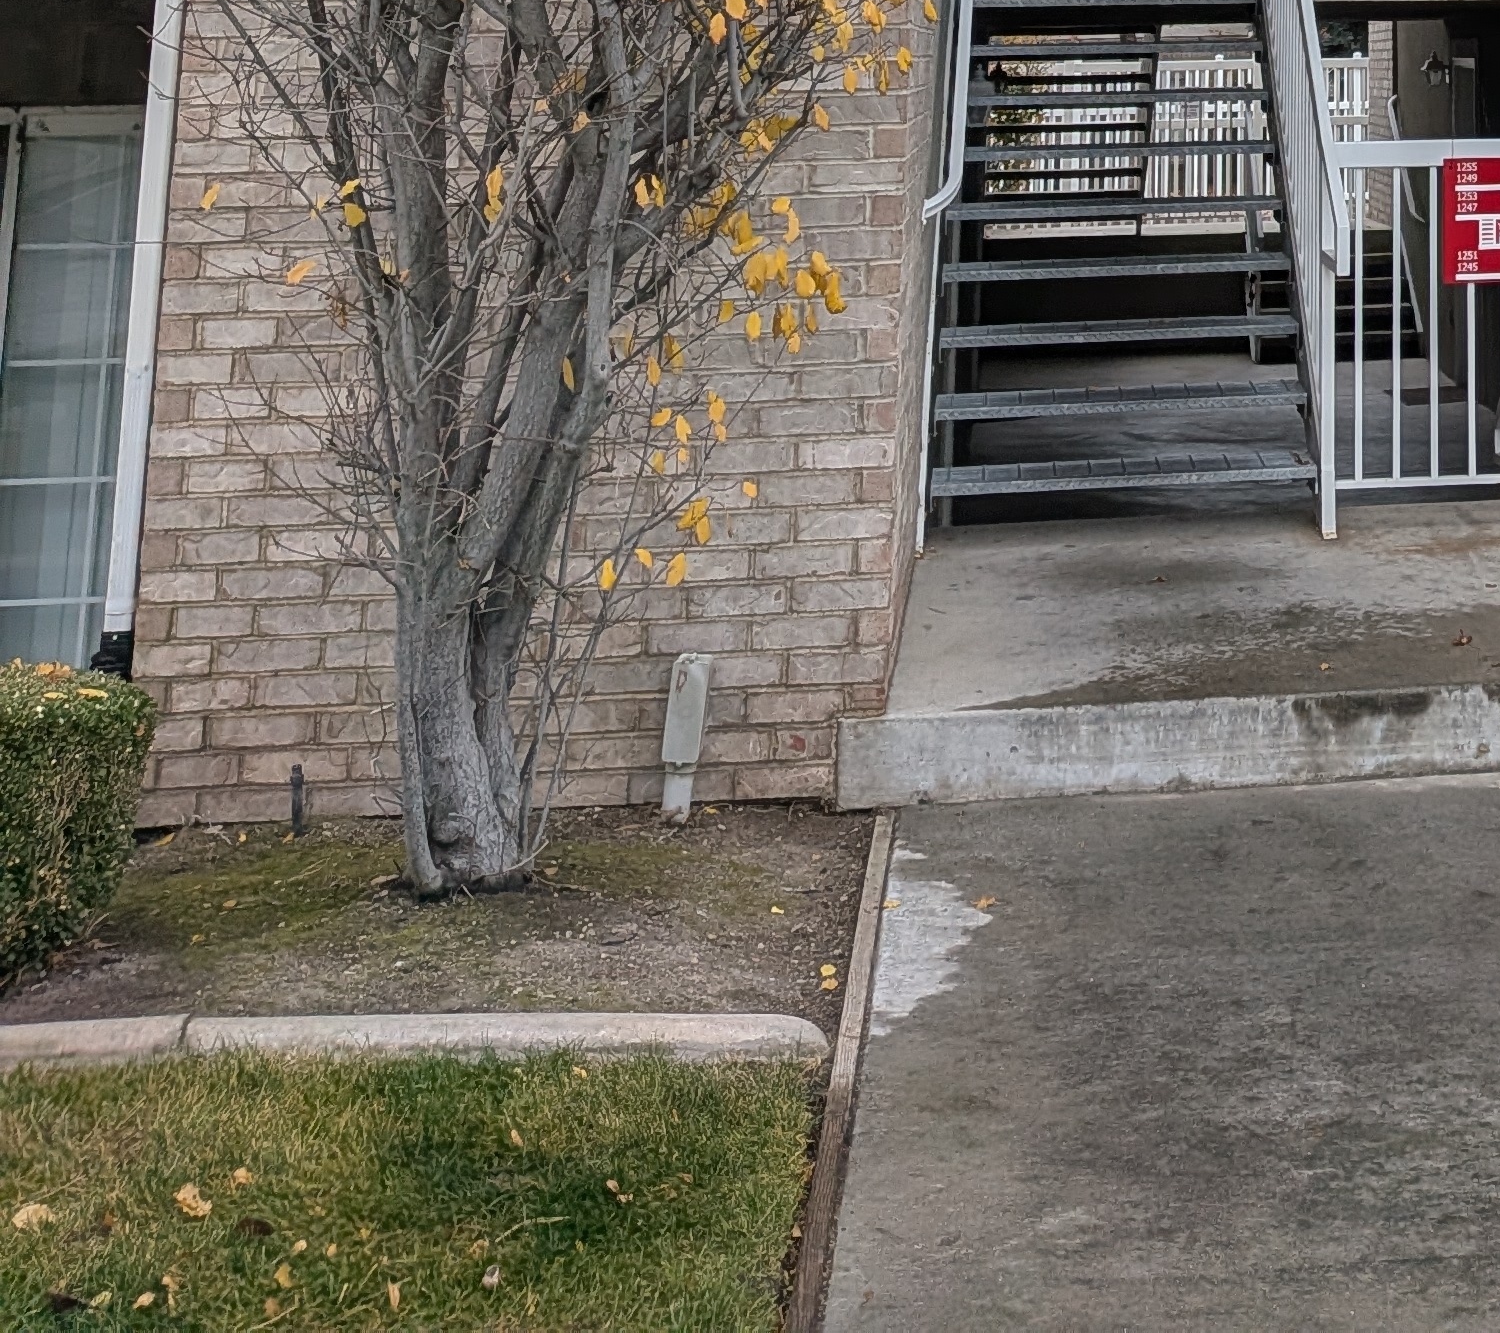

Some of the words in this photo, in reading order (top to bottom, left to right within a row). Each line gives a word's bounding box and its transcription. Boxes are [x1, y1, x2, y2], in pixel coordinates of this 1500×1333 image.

[1456, 162, 1478, 172] 1255
[1456, 174, 1478, 184] 1249
[1458, 192, 1478, 202] 1253
[1458, 202, 1478, 212] 1247
[1458, 250, 1478, 260] 1251
[1458, 262, 1478, 272] 1245
